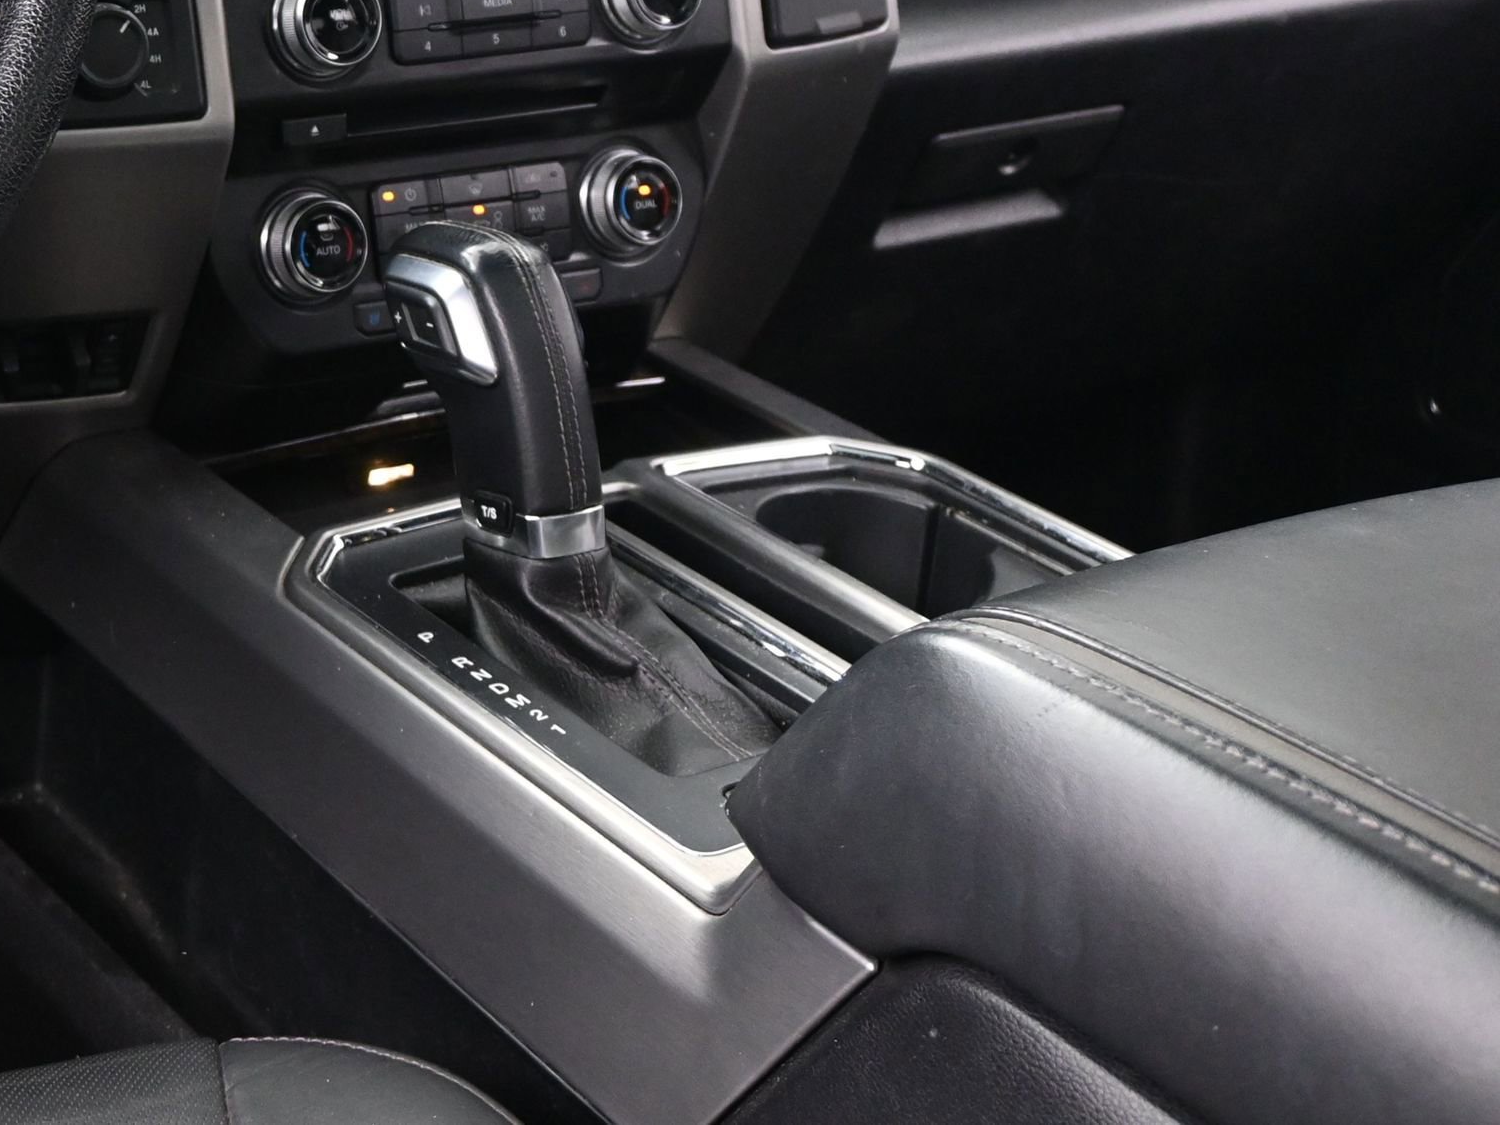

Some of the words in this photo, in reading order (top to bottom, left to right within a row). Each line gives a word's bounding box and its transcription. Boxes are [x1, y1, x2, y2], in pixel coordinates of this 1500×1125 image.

[134, 4, 147, 14] 2H
[559, 25, 567, 37] 6
[492, 33, 500, 45] 5
[424, 40, 432, 51] 4
[149, 54, 162, 64] 4H
[635, 200, 658, 210] DUAL
[316, 245, 341, 256] AUTO
[481, 505, 498, 520] T/S
[417, 631, 434, 643] P
[451, 656, 474, 669] R
[470, 668, 493, 681] N
[488, 682, 510, 695] D
[504, 693, 531, 708] M
[529, 708, 549, 722] 2
[550, 723, 567, 735] 1
